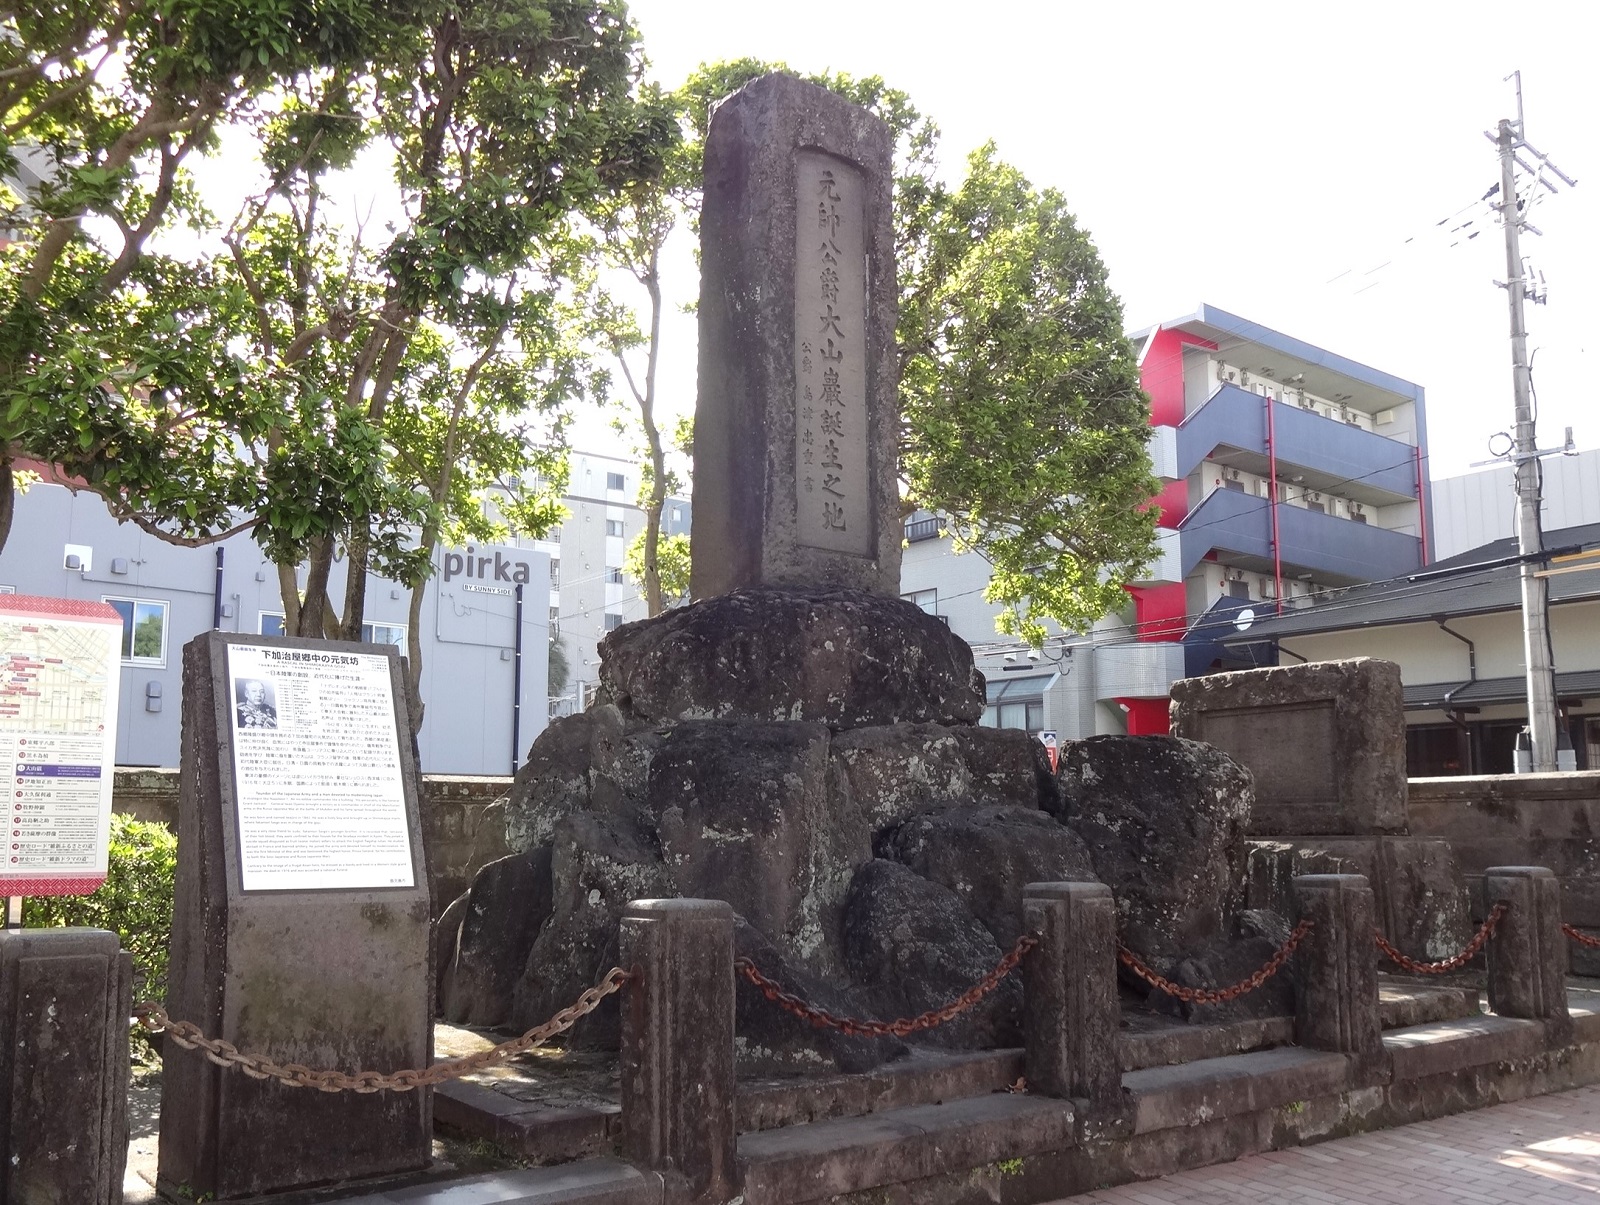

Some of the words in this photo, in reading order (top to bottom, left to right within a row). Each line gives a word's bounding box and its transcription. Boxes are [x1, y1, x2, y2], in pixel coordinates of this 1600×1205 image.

[444, 546, 530, 584] pirka
[474, 585, 496, 593] SUNNY
[262, 649, 359, 666] 下加治屋郷中の元気坊
